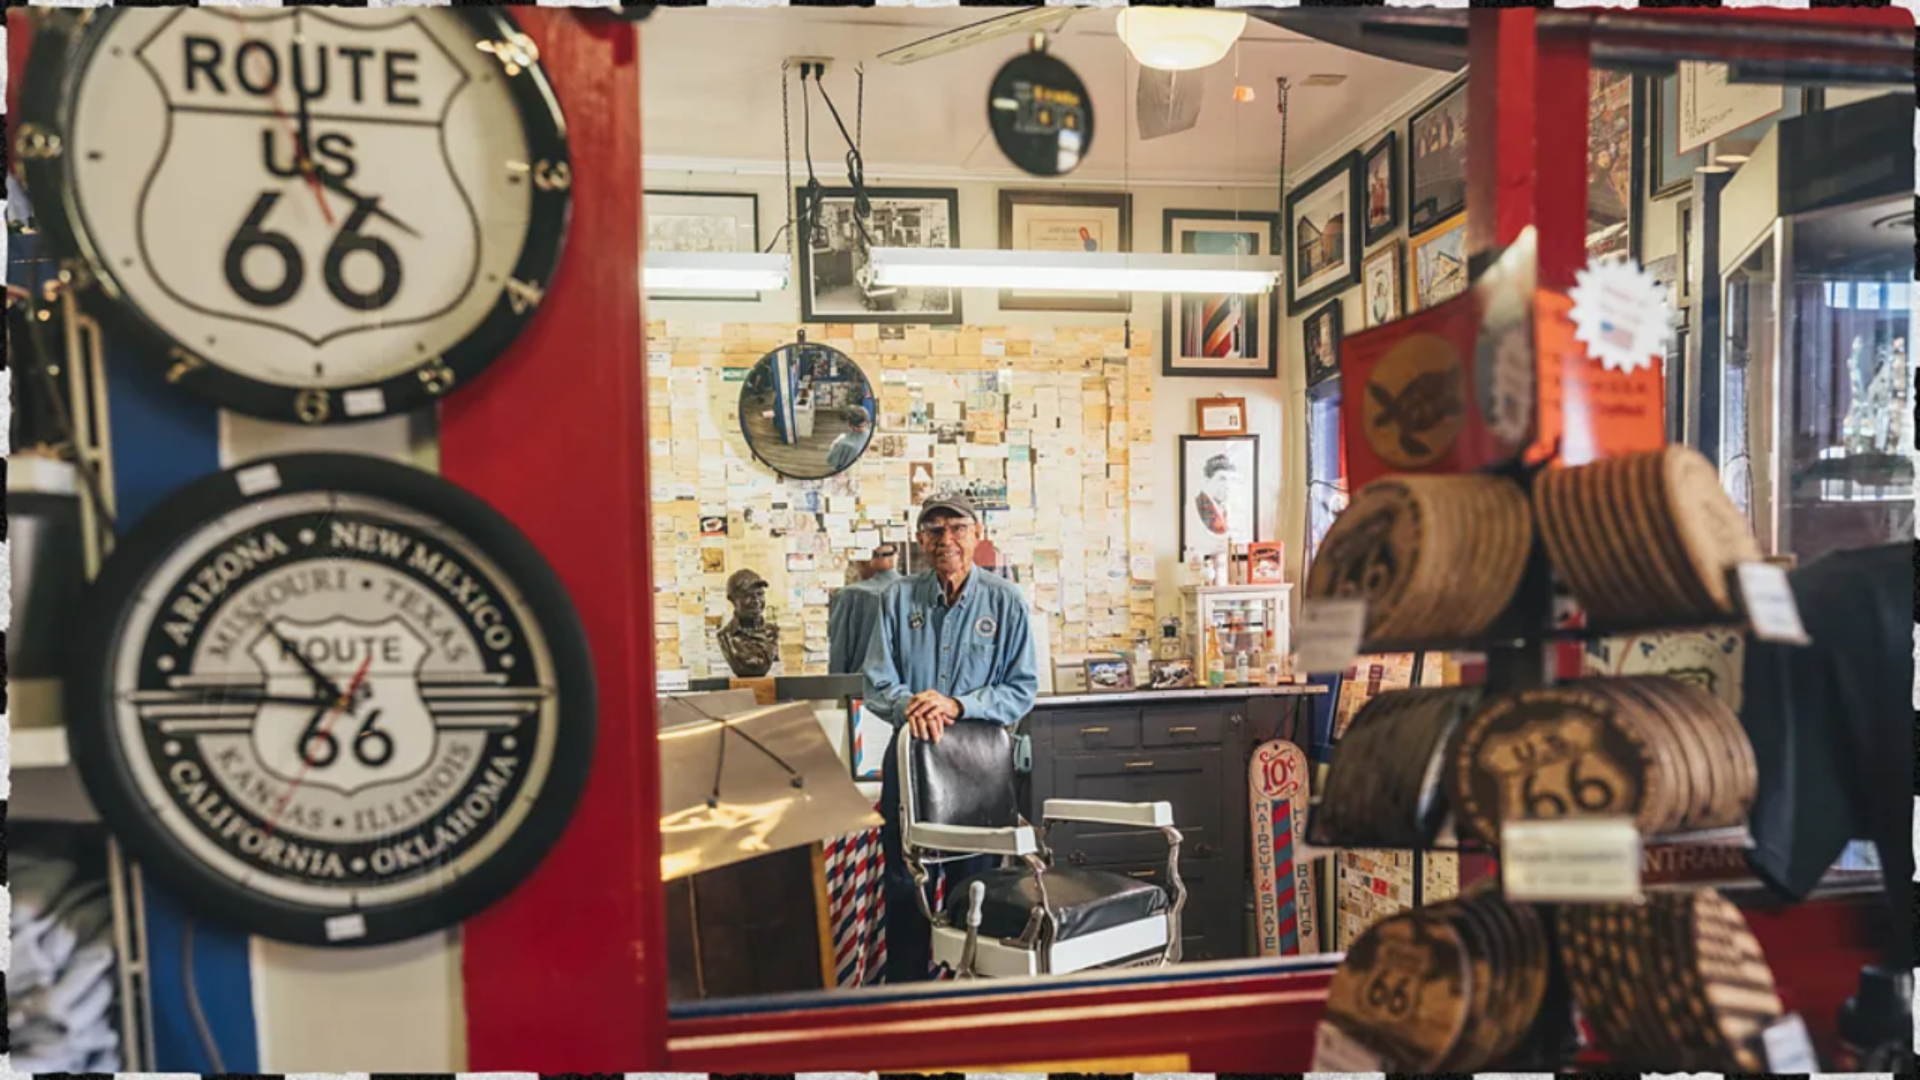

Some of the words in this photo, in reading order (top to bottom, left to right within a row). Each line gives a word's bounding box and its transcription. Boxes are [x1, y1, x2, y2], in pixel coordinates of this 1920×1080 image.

[184, 36, 421, 106] ROUTE
[223, 191, 403, 310] 66
[163, 532, 290, 647] ARIZONA
[331, 521, 410, 559] NEW
[407, 543, 513, 651] MEXICO
[384, 577, 470, 663] TEXAS
[296, 708, 395, 768] 66
[169, 759, 346, 878] CALIFORNIA
[371, 757, 519, 875] OKLAHOMA
[353, 741, 472, 833] ILLINOIS
[1256, 802, 1272, 877] HAIRCUT
[1261, 893, 1275, 949] SHAVE
